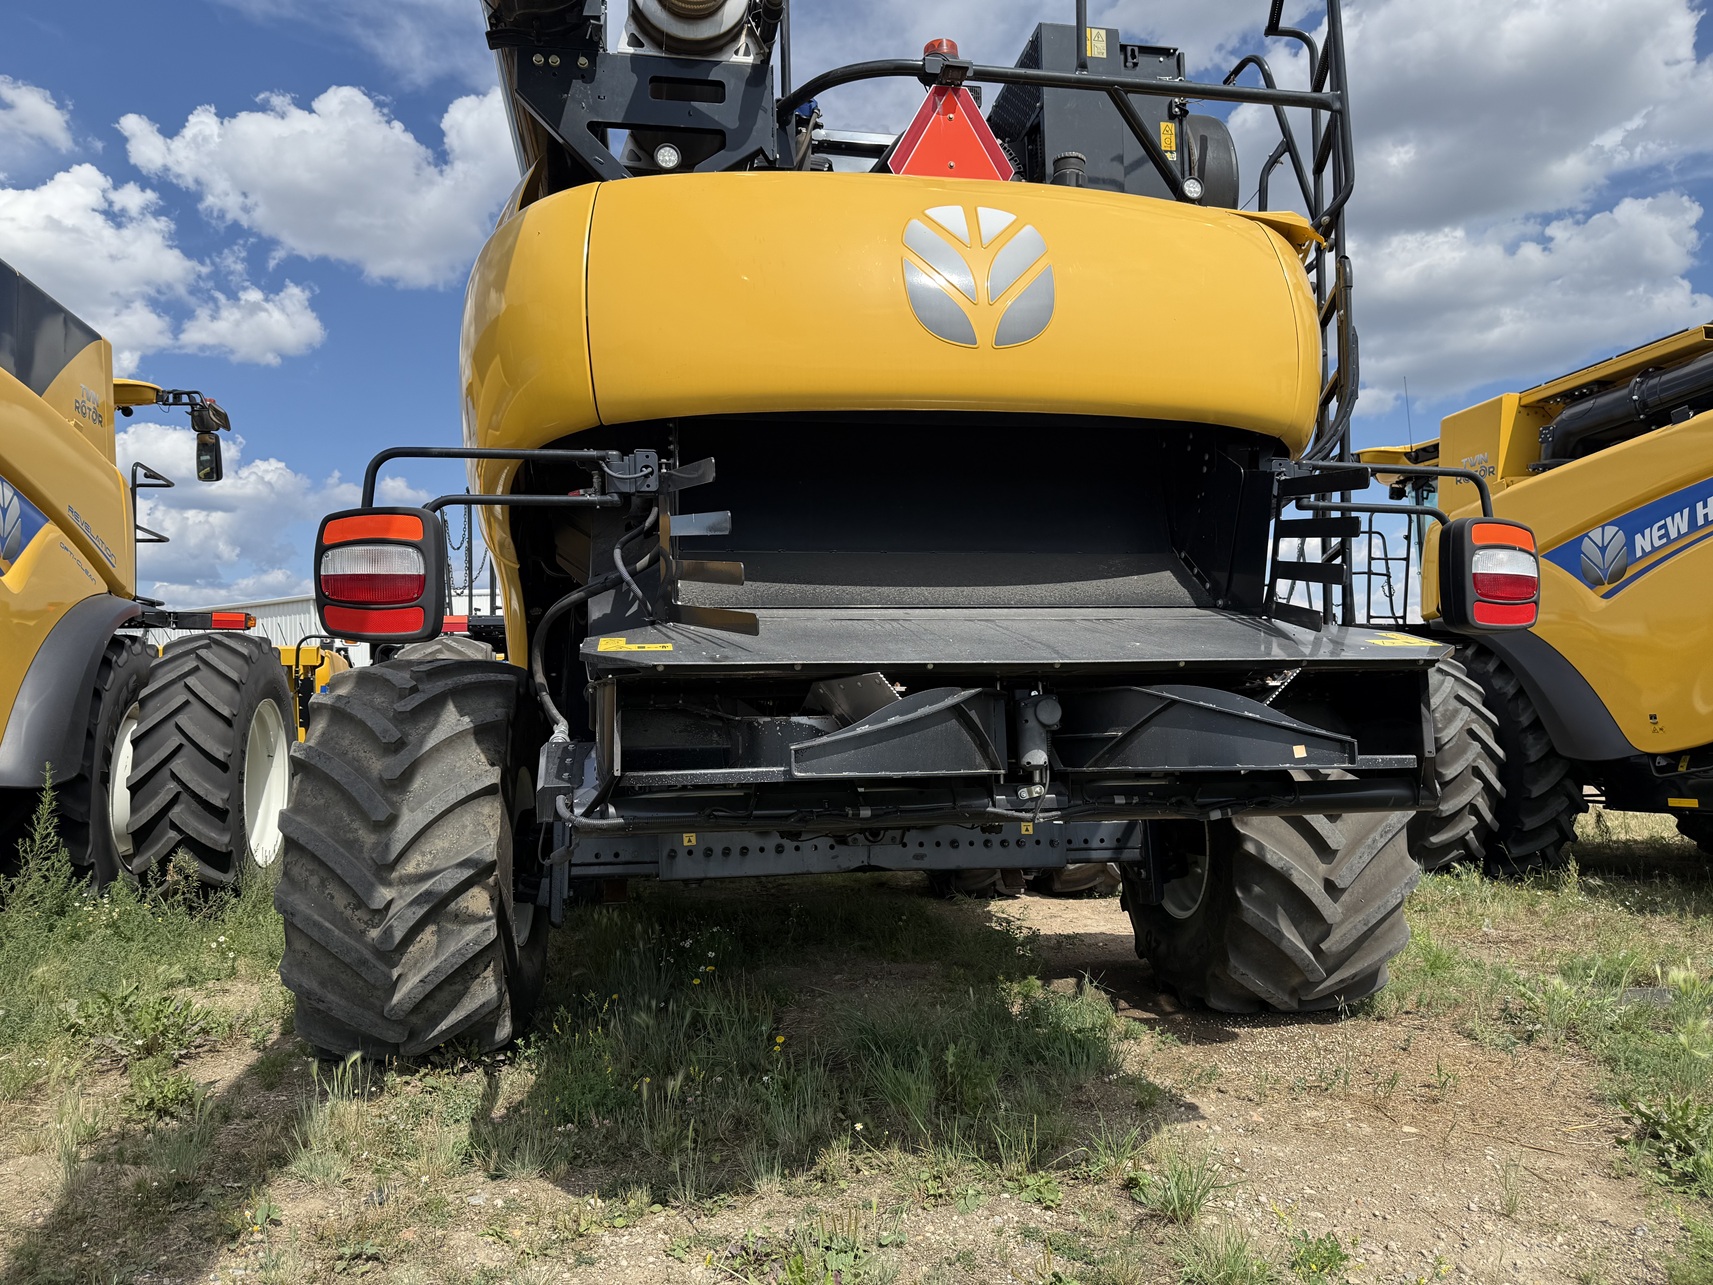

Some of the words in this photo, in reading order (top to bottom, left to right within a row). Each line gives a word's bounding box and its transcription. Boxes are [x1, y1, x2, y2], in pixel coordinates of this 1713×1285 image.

[80, 383, 99, 407] TWIN
[74, 398, 103, 428] ROTOR
[1461, 452, 1488, 470] TWIN
[1455, 465, 1496, 485] ROOR
[68, 504, 117, 567] REVELATION
[1634, 507, 1690, 558] NEW
